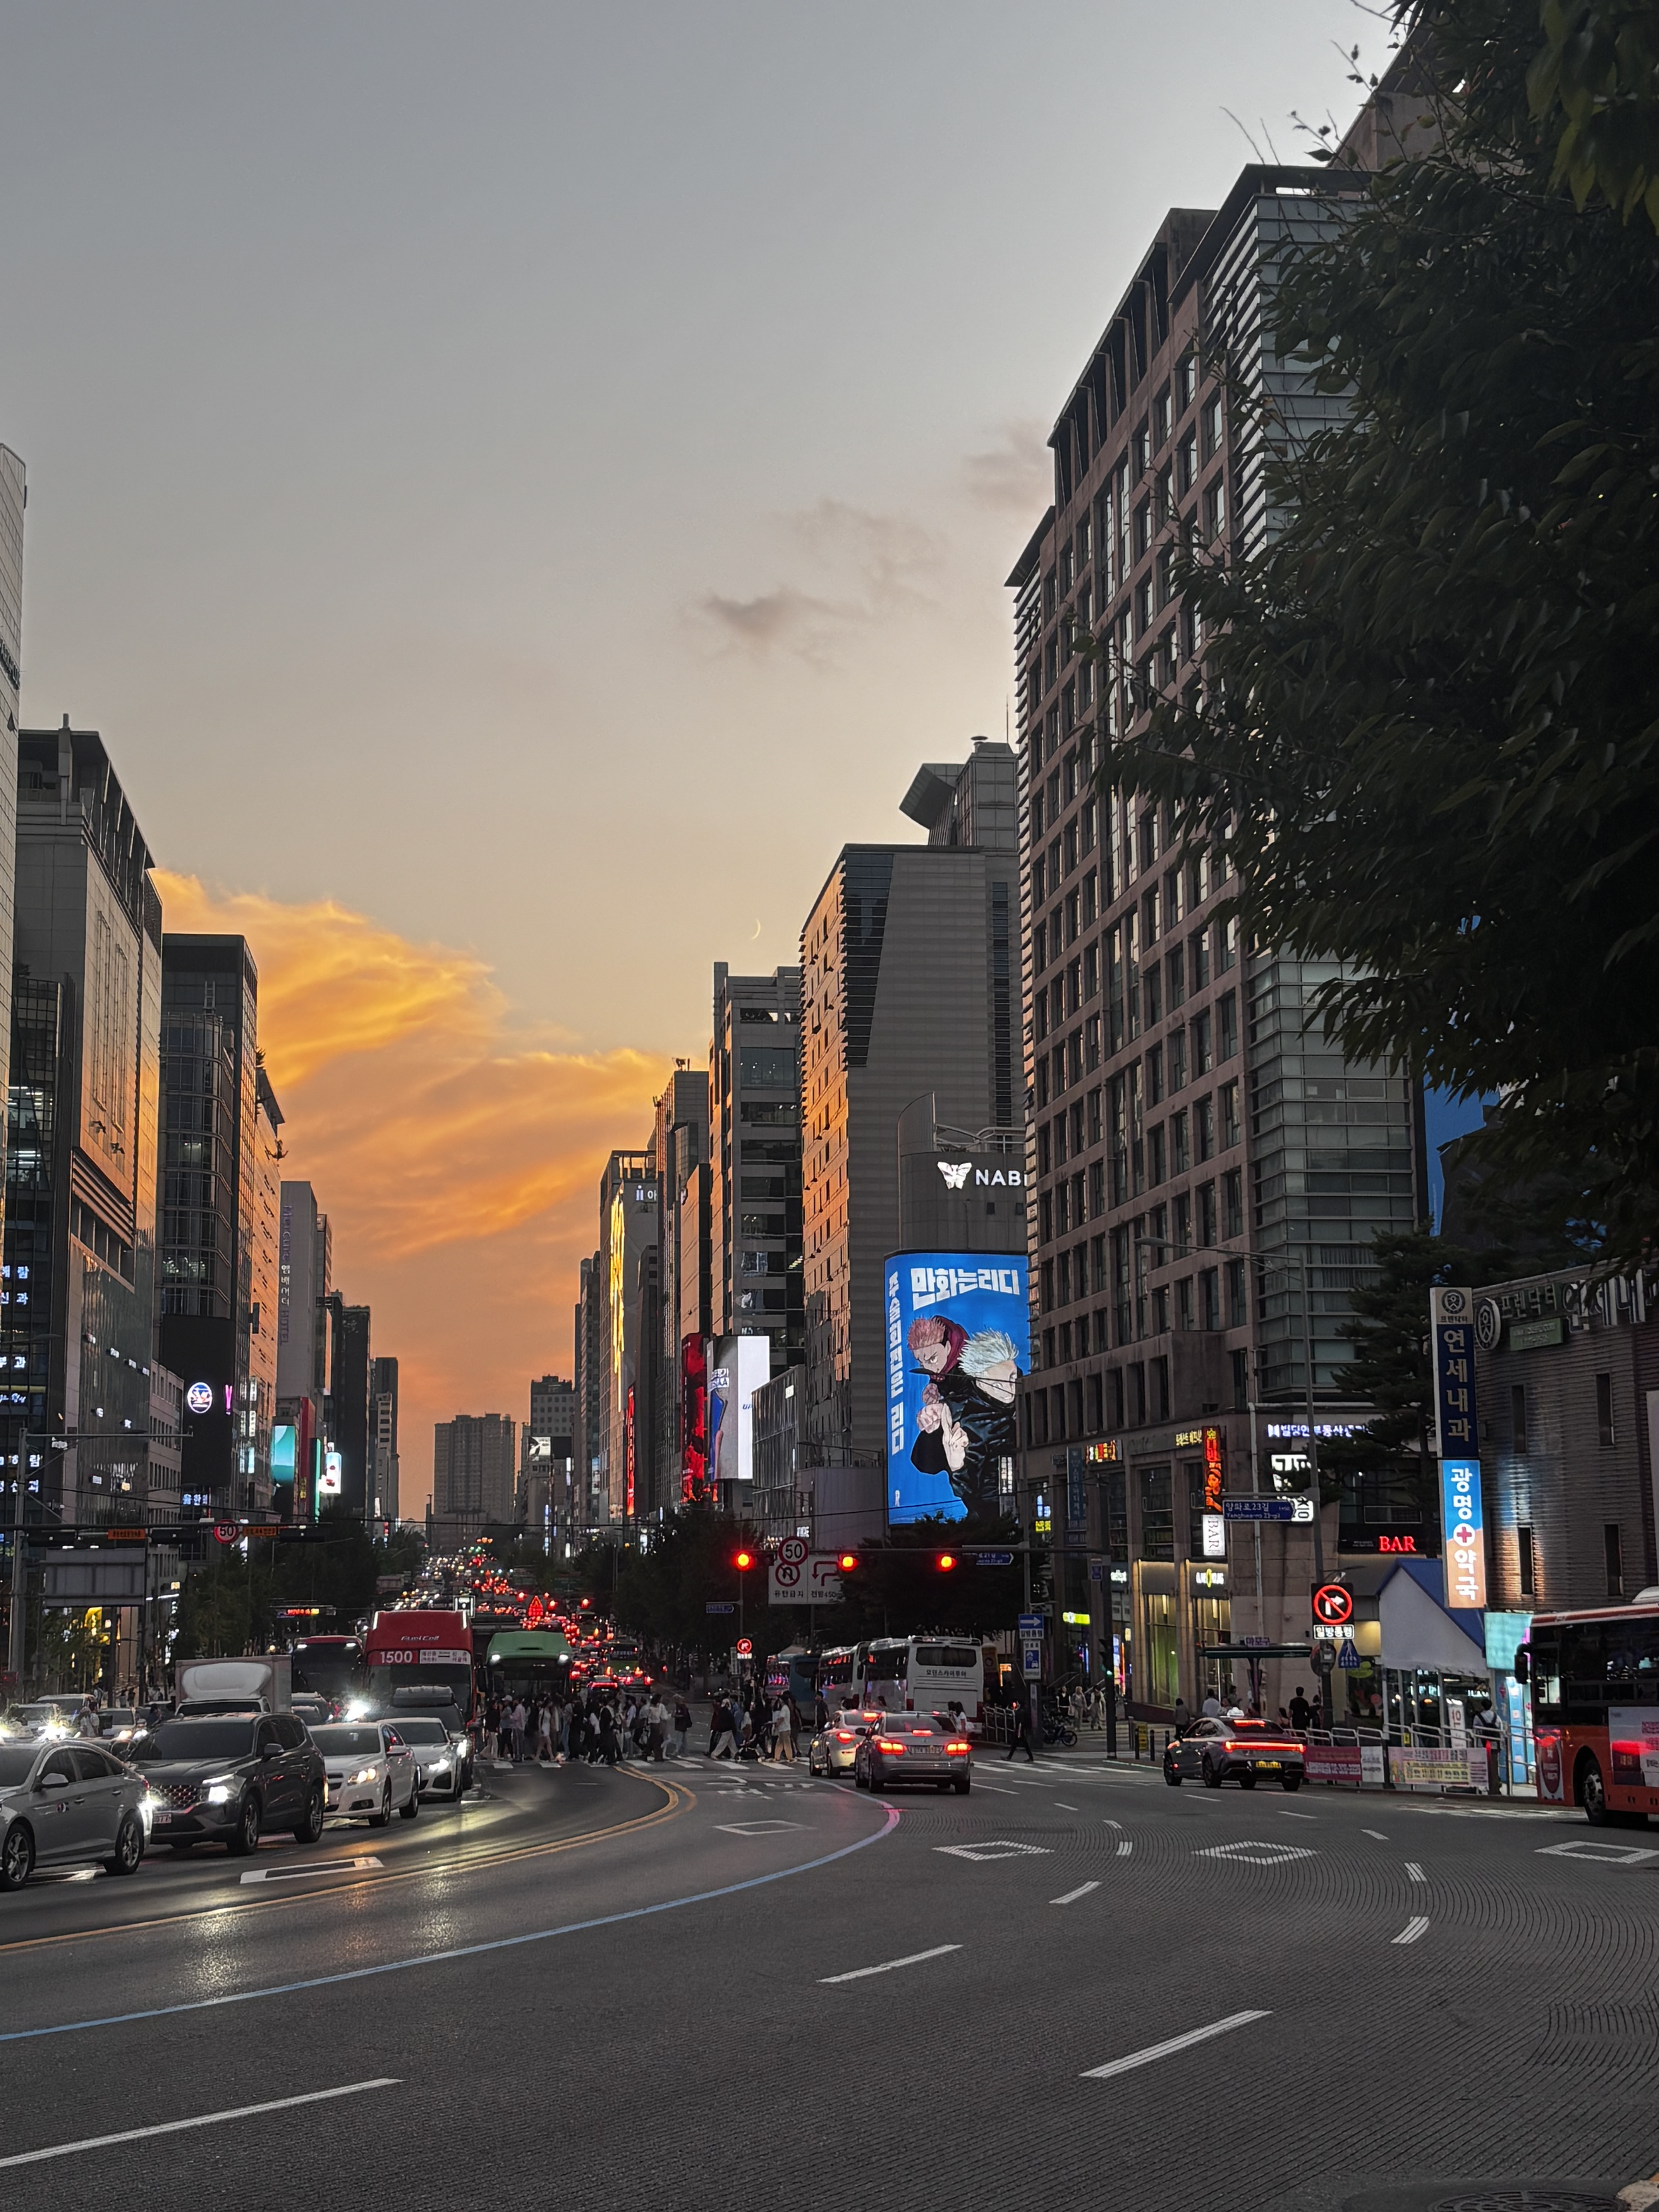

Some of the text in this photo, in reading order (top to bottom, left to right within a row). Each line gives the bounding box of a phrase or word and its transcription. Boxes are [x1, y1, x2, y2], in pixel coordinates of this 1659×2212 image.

[281, 1205, 292, 1261] Mercure
[1563, 1267, 1659, 1334] 연세내
[1443, 1329, 1472, 1442] 연세내과
[891, 1401, 904, 1456] 리디
[1226, 1502, 1269, 1512] 양화로23길
[220, 1525, 234, 1537] 50
[1208, 1520, 1219, 1549] BAR
[1379, 1536, 1417, 1551] BAR
[1451, 1467, 1479, 1601] 광명 약국
[785, 1543, 802, 1559] 50
[380, 1650, 413, 1664] 1500
